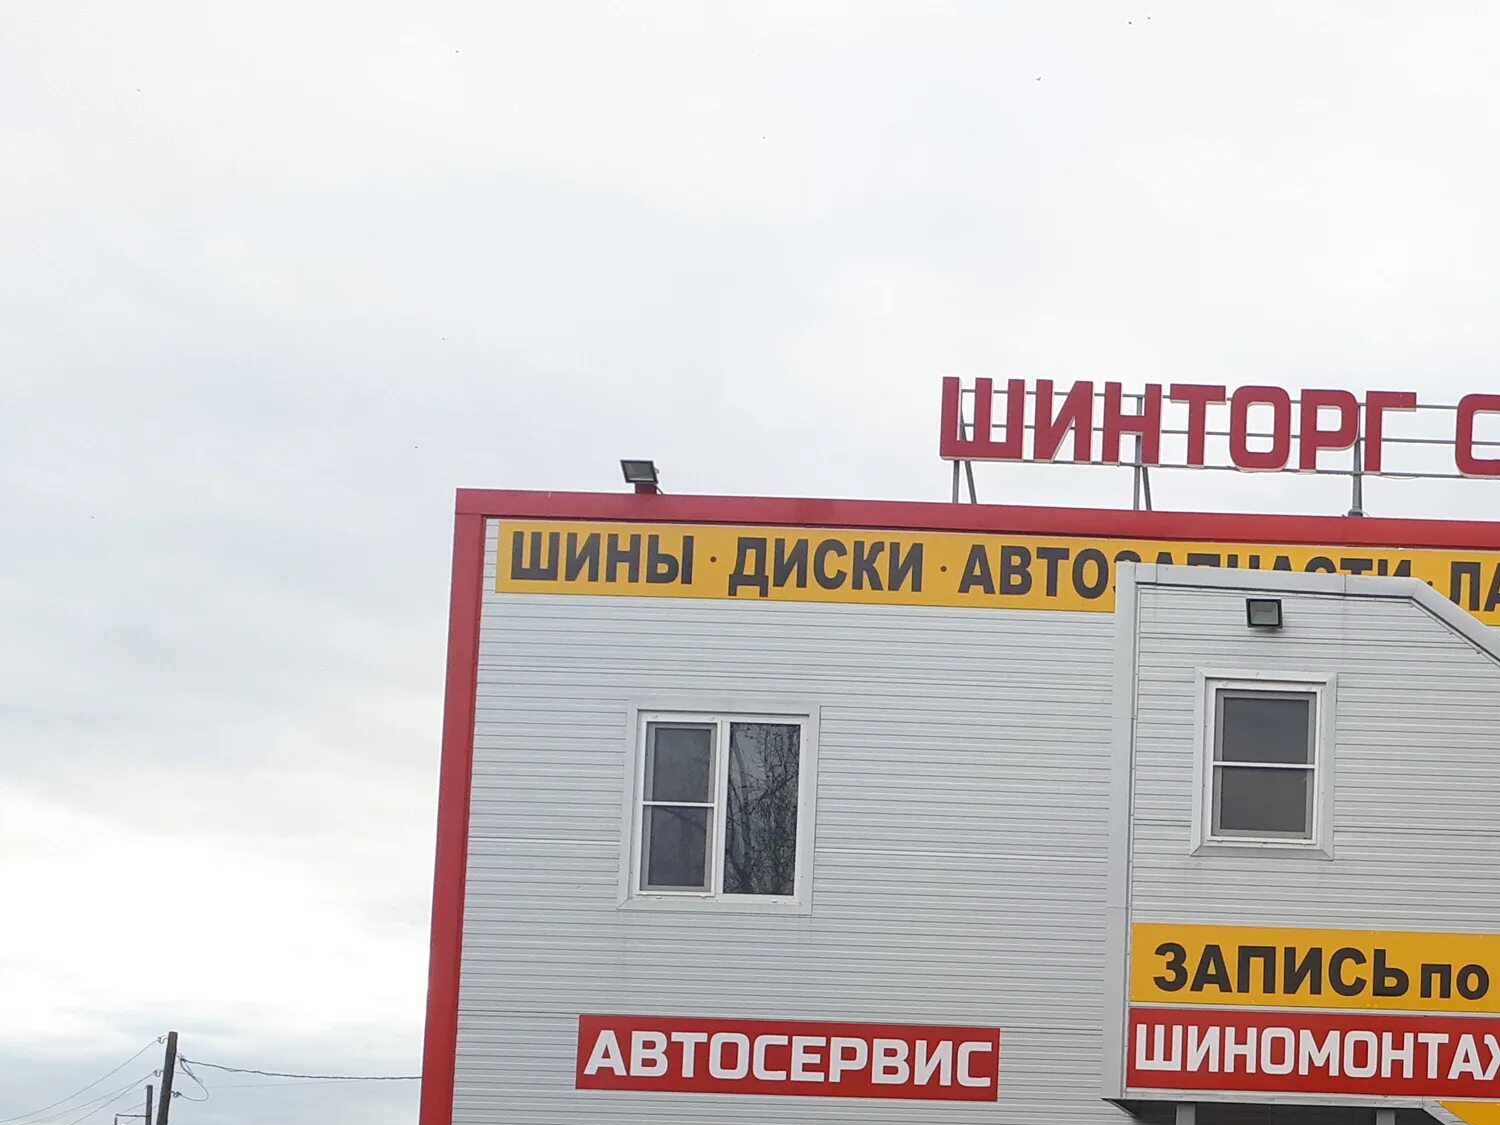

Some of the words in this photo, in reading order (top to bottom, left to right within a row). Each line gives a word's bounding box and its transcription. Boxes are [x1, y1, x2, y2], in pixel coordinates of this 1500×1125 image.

[939, 377, 1417, 473] ШИНТОРГ
[510, 531, 695, 584] ШИНЫ
[728, 536, 925, 597] ДИСКИ
[1153, 942, 1409, 997] ЗАПИСЬ
[1420, 964, 1490, 1000] по
[583, 1029, 993, 1087] АВТОСЕРВИС
